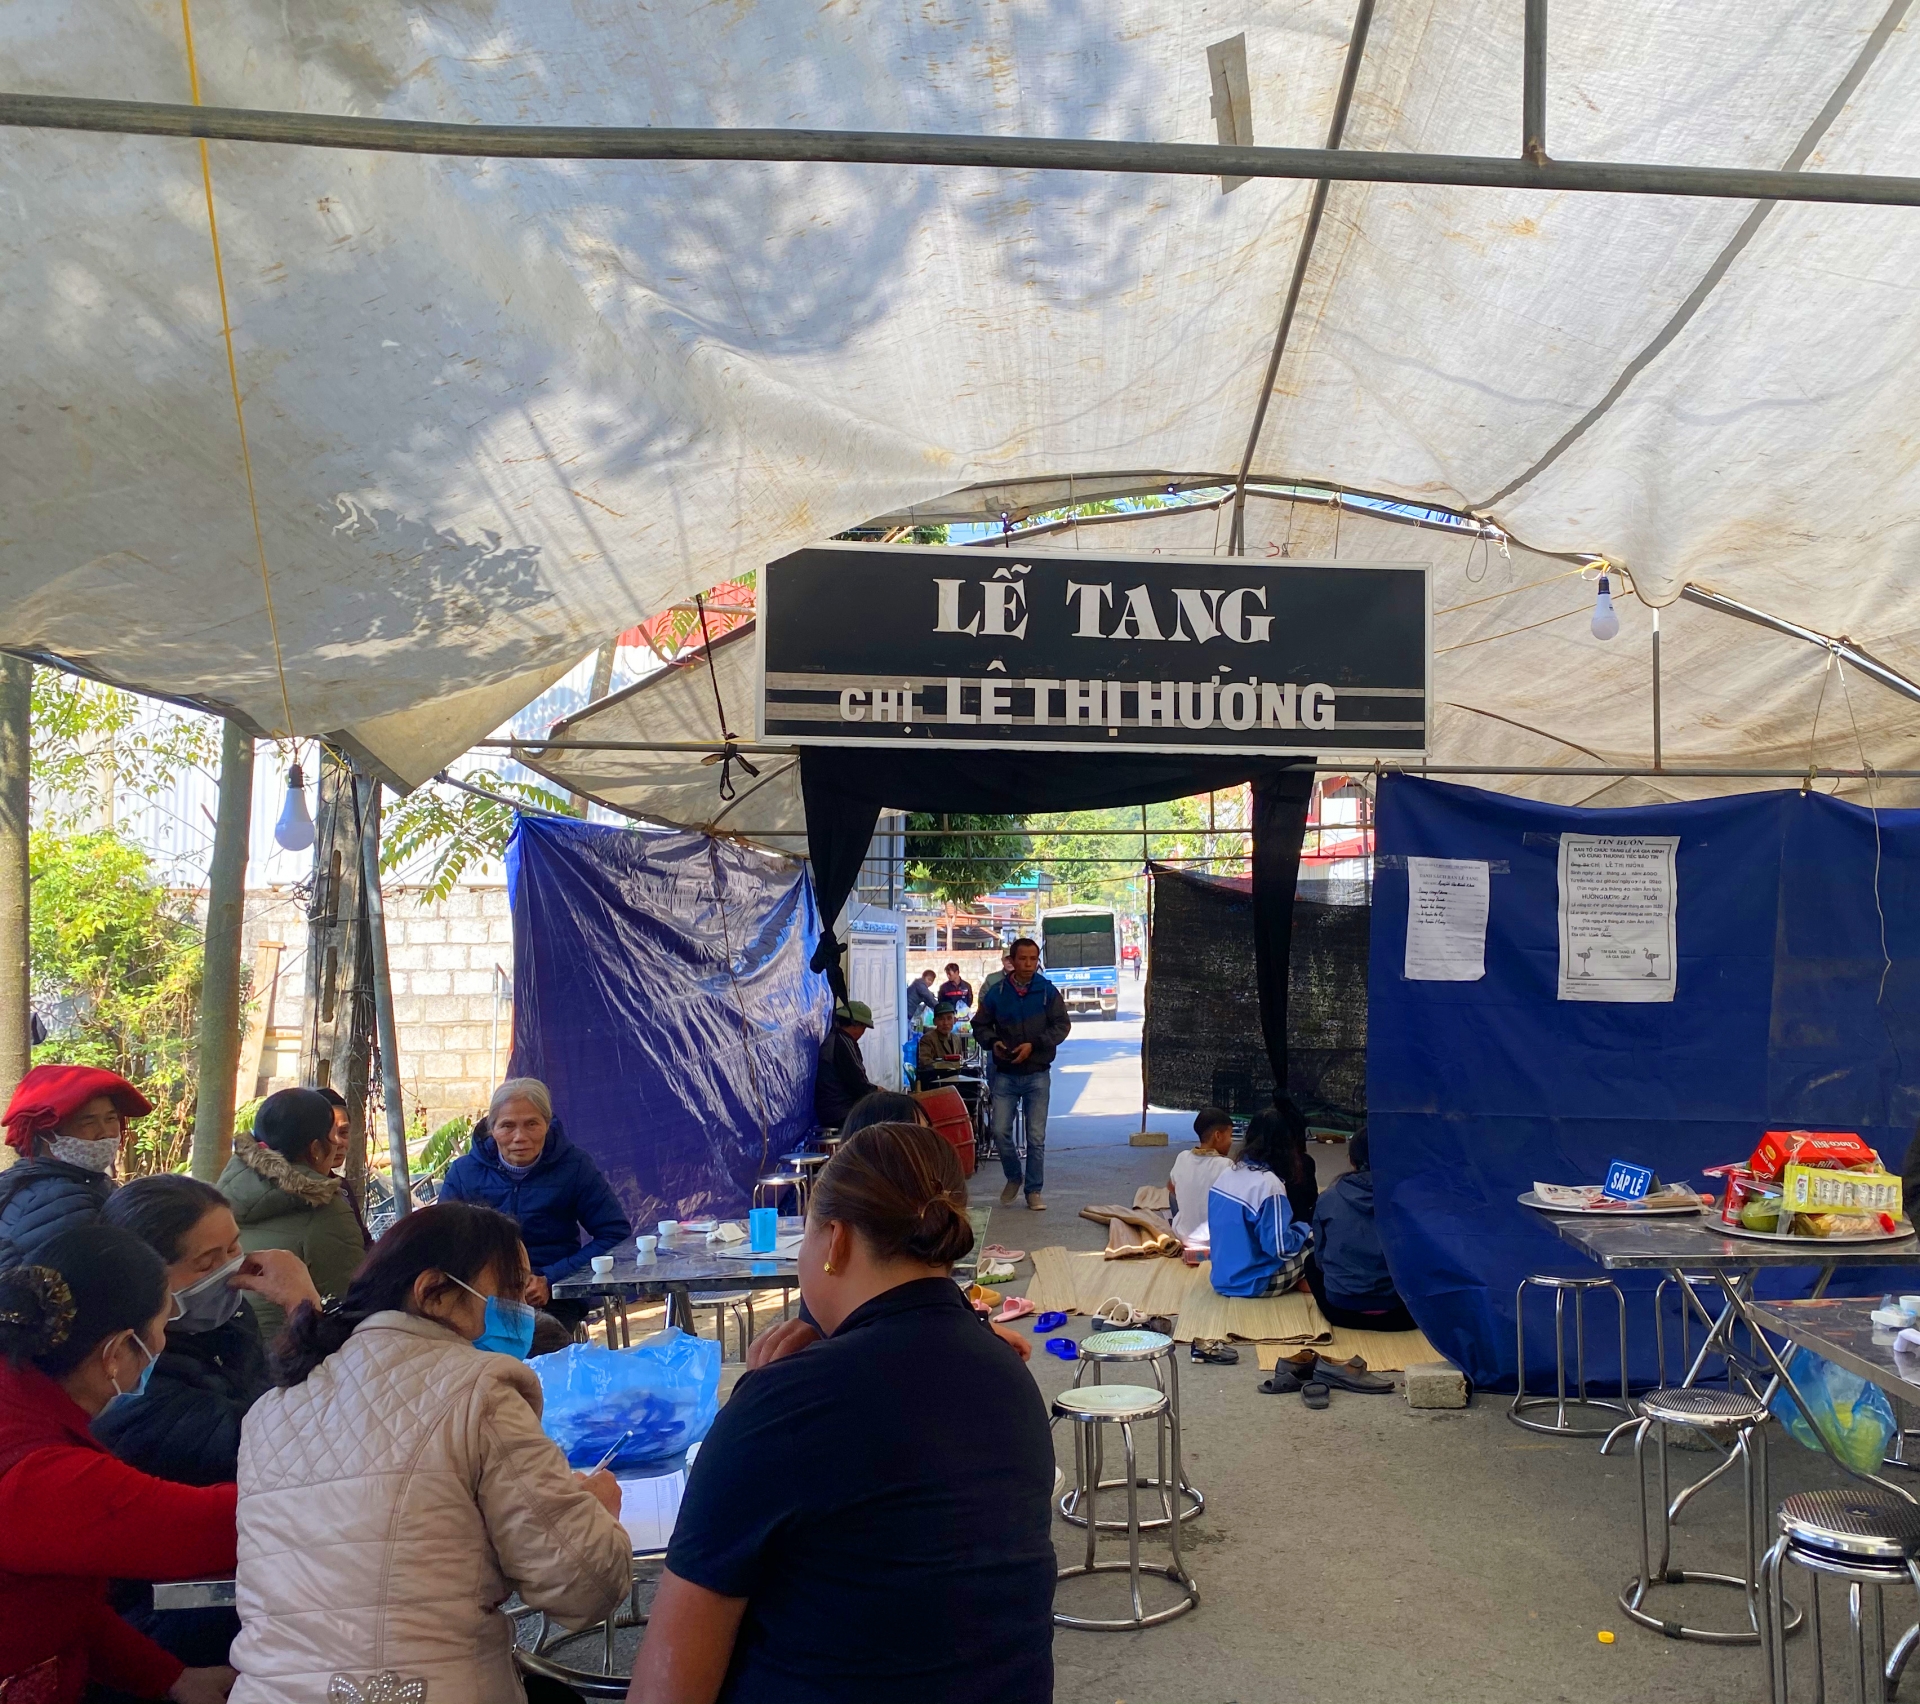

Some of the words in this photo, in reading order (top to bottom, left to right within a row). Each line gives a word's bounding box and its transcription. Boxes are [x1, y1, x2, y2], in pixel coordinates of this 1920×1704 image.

[932, 564, 1032, 641] LỄ
[1066, 579, 1275, 644] TANG
[947, 660, 1012, 724] LÊ
[1024, 678, 1121, 736] THỊ
